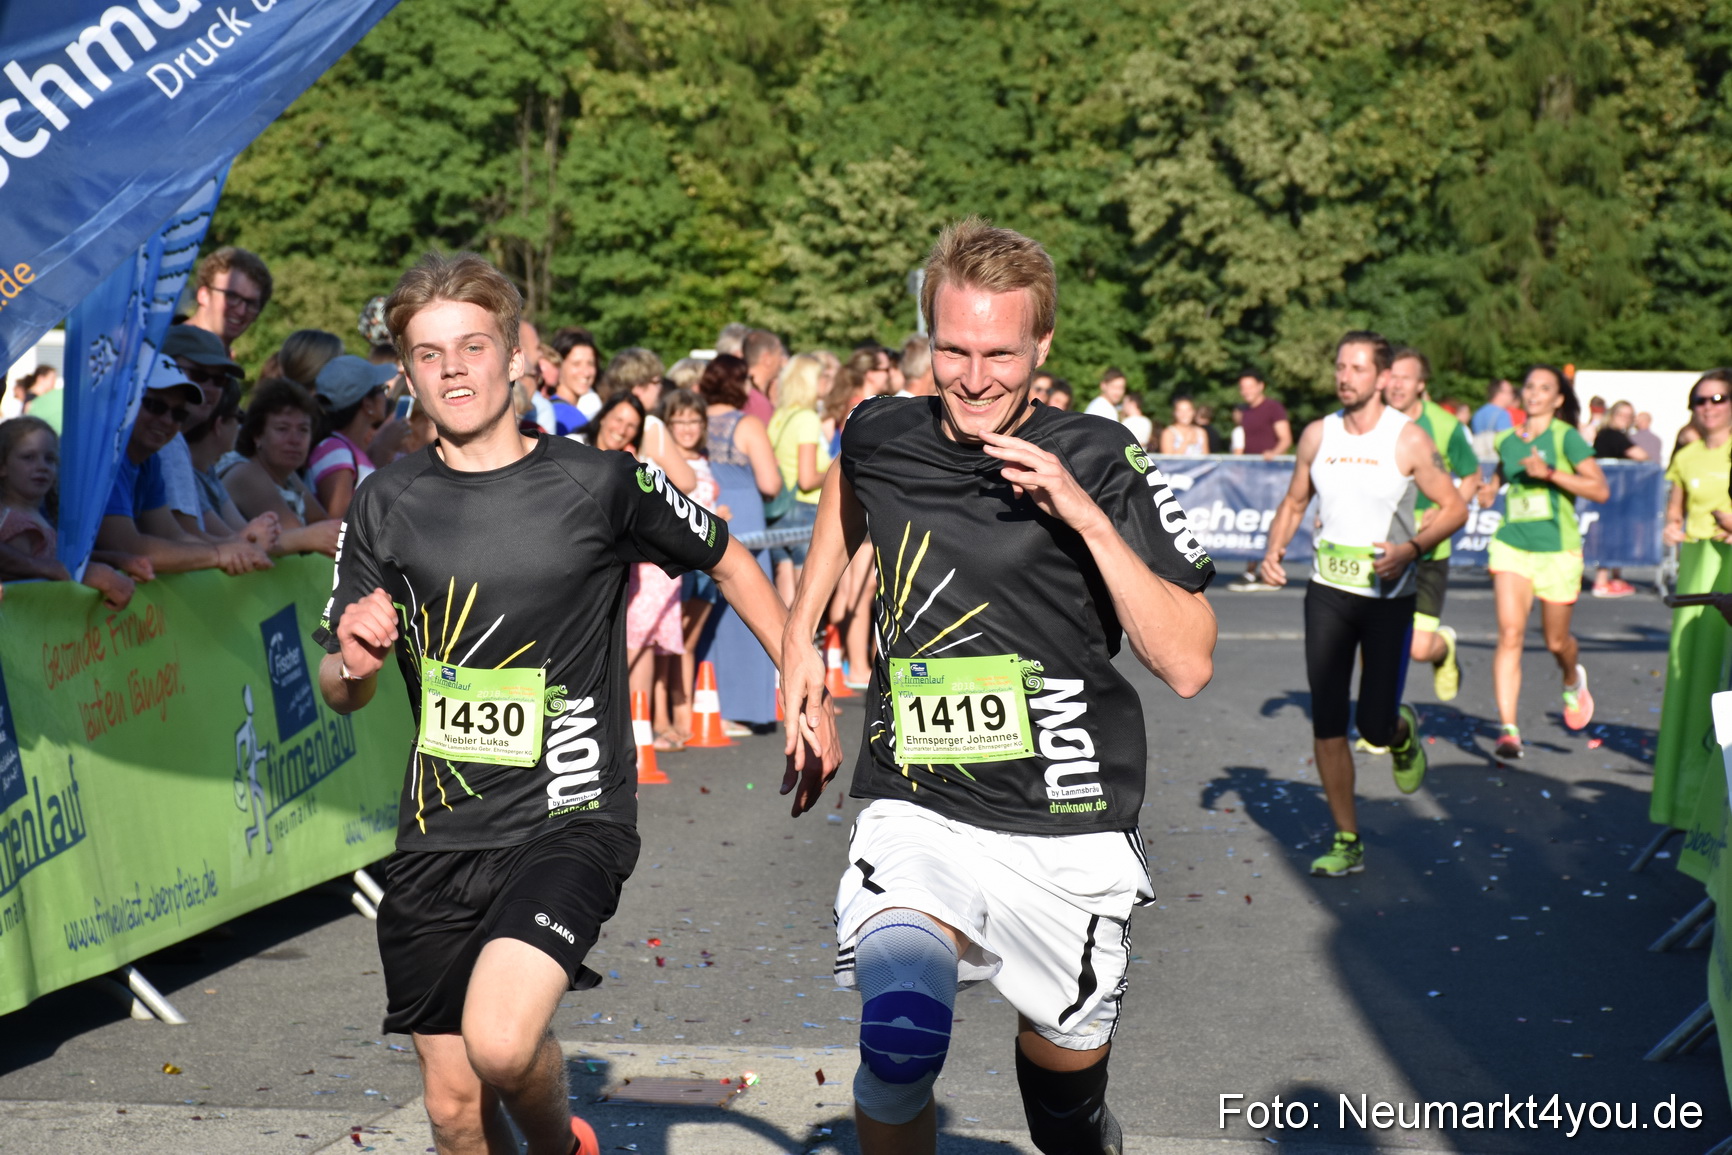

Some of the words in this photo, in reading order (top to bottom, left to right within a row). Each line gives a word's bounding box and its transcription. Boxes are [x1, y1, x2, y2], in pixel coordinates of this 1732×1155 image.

[146, 7, 251, 99] Druck
[0, 262, 36, 312] .de
[1186, 500, 1276, 533] cher
[1328, 556, 1360, 576] 859
[434, 675, 472, 691] firmenlauf
[904, 675, 945, 684] firmenlauf
[951, 681, 976, 691] 2018
[434, 696, 525, 737] 1430
[908, 694, 1007, 733] 1419
[444, 733, 477, 745] Niebler
[480, 736, 509, 747] Lukas
[906, 735, 964, 747] Ehrnsperger
[966, 733, 1019, 744] Johannes
[978, 741, 1013, 751] Ehrnsperger
[1051, 790, 1060, 798] by
[1061, 786, 1100, 796] Lammsbräu
[1049, 798, 1108, 814] drinknow.de
[549, 922, 575, 945] JAKO
